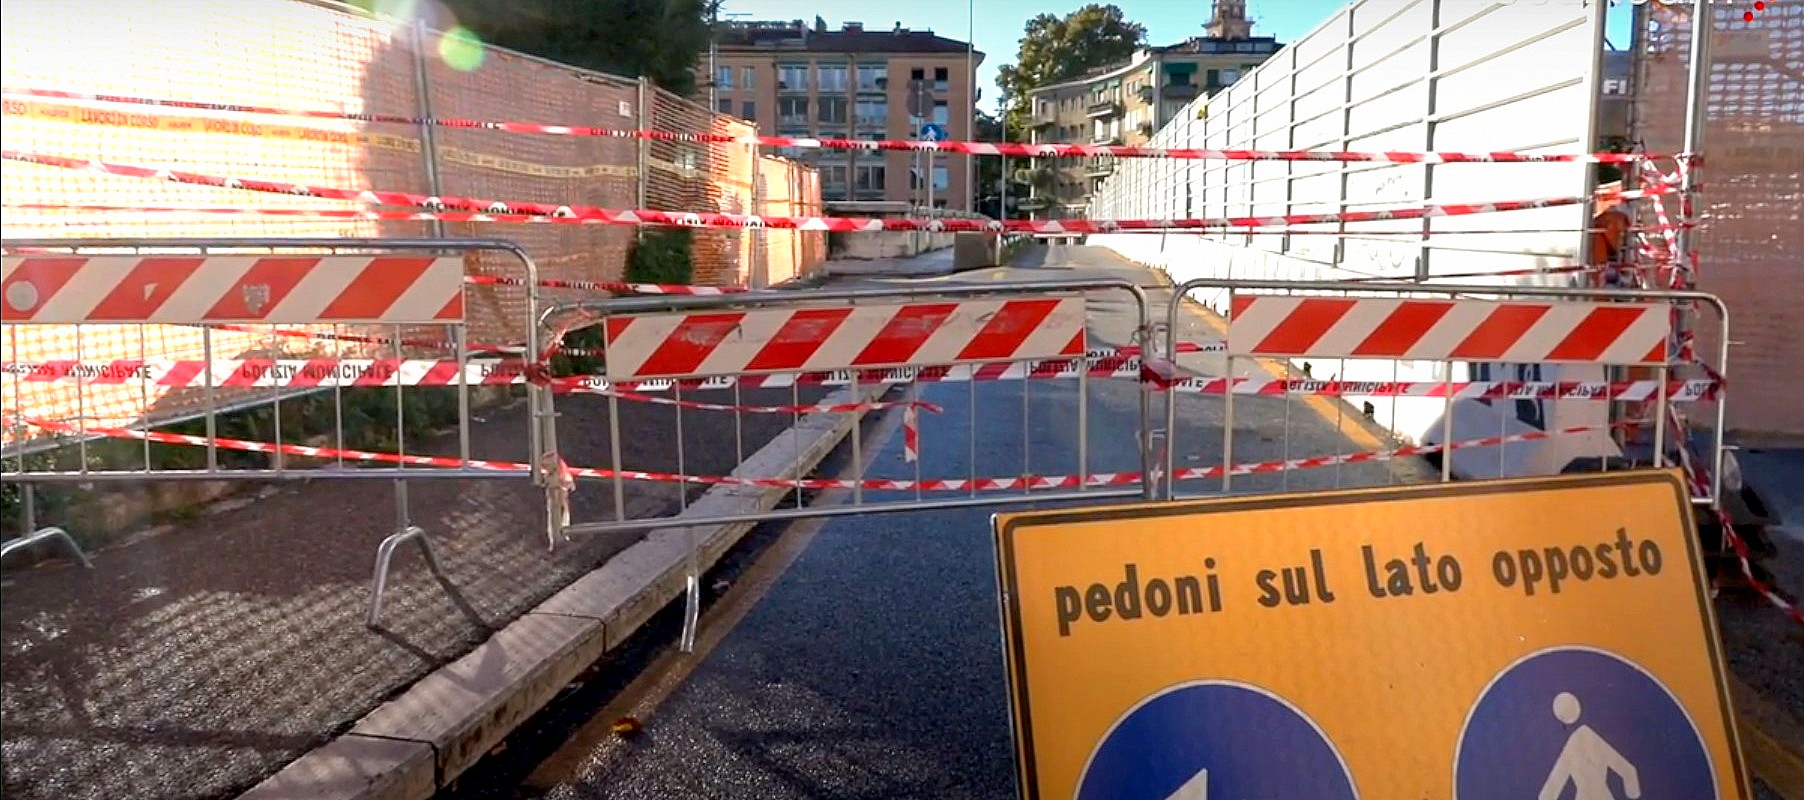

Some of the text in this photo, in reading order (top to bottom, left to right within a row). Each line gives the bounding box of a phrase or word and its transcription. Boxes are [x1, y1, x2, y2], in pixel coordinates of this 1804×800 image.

[1054, 527, 1663, 637] pedoni sul lato opposto
